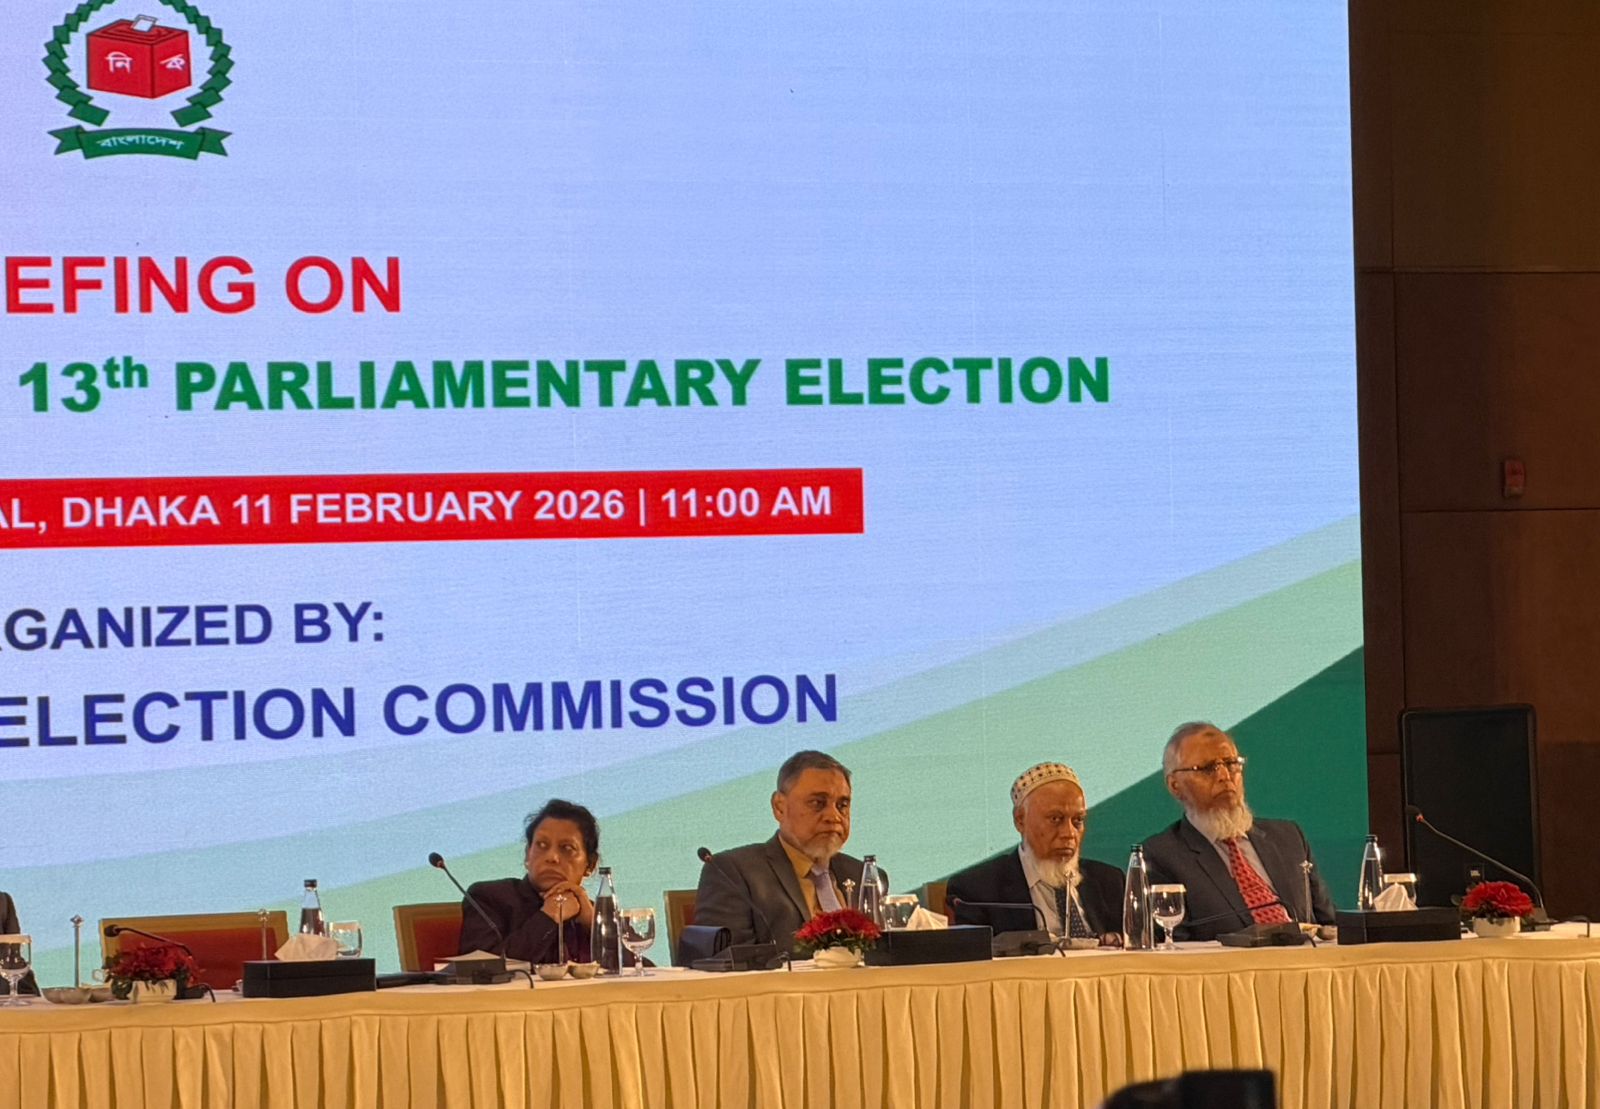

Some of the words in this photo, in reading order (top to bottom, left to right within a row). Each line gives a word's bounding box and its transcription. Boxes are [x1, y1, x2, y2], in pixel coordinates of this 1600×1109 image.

[96, 135, 184, 150] বাংলাদেশ
[5, 256, 257, 315] EFING
[286, 256, 402, 315] ON
[20, 356, 149, 413] 13th
[176, 359, 761, 412] PARLIAMENTARY
[785, 357, 1110, 406] ELECTION
[0, 498, 47, 535] L,
[63, 495, 220, 528] DHAKA
[233, 494, 271, 525] 11
[290, 490, 521, 524] FEBRUARY
[534, 489, 625, 520] 2026
[661, 487, 760, 518] 11:00
[771, 486, 832, 516] AM
[0, 604, 273, 652] GANIZED
[294, 601, 384, 644] BY:
[0, 687, 356, 748] ELECTION
[383, 673, 838, 736] COMMISSION
